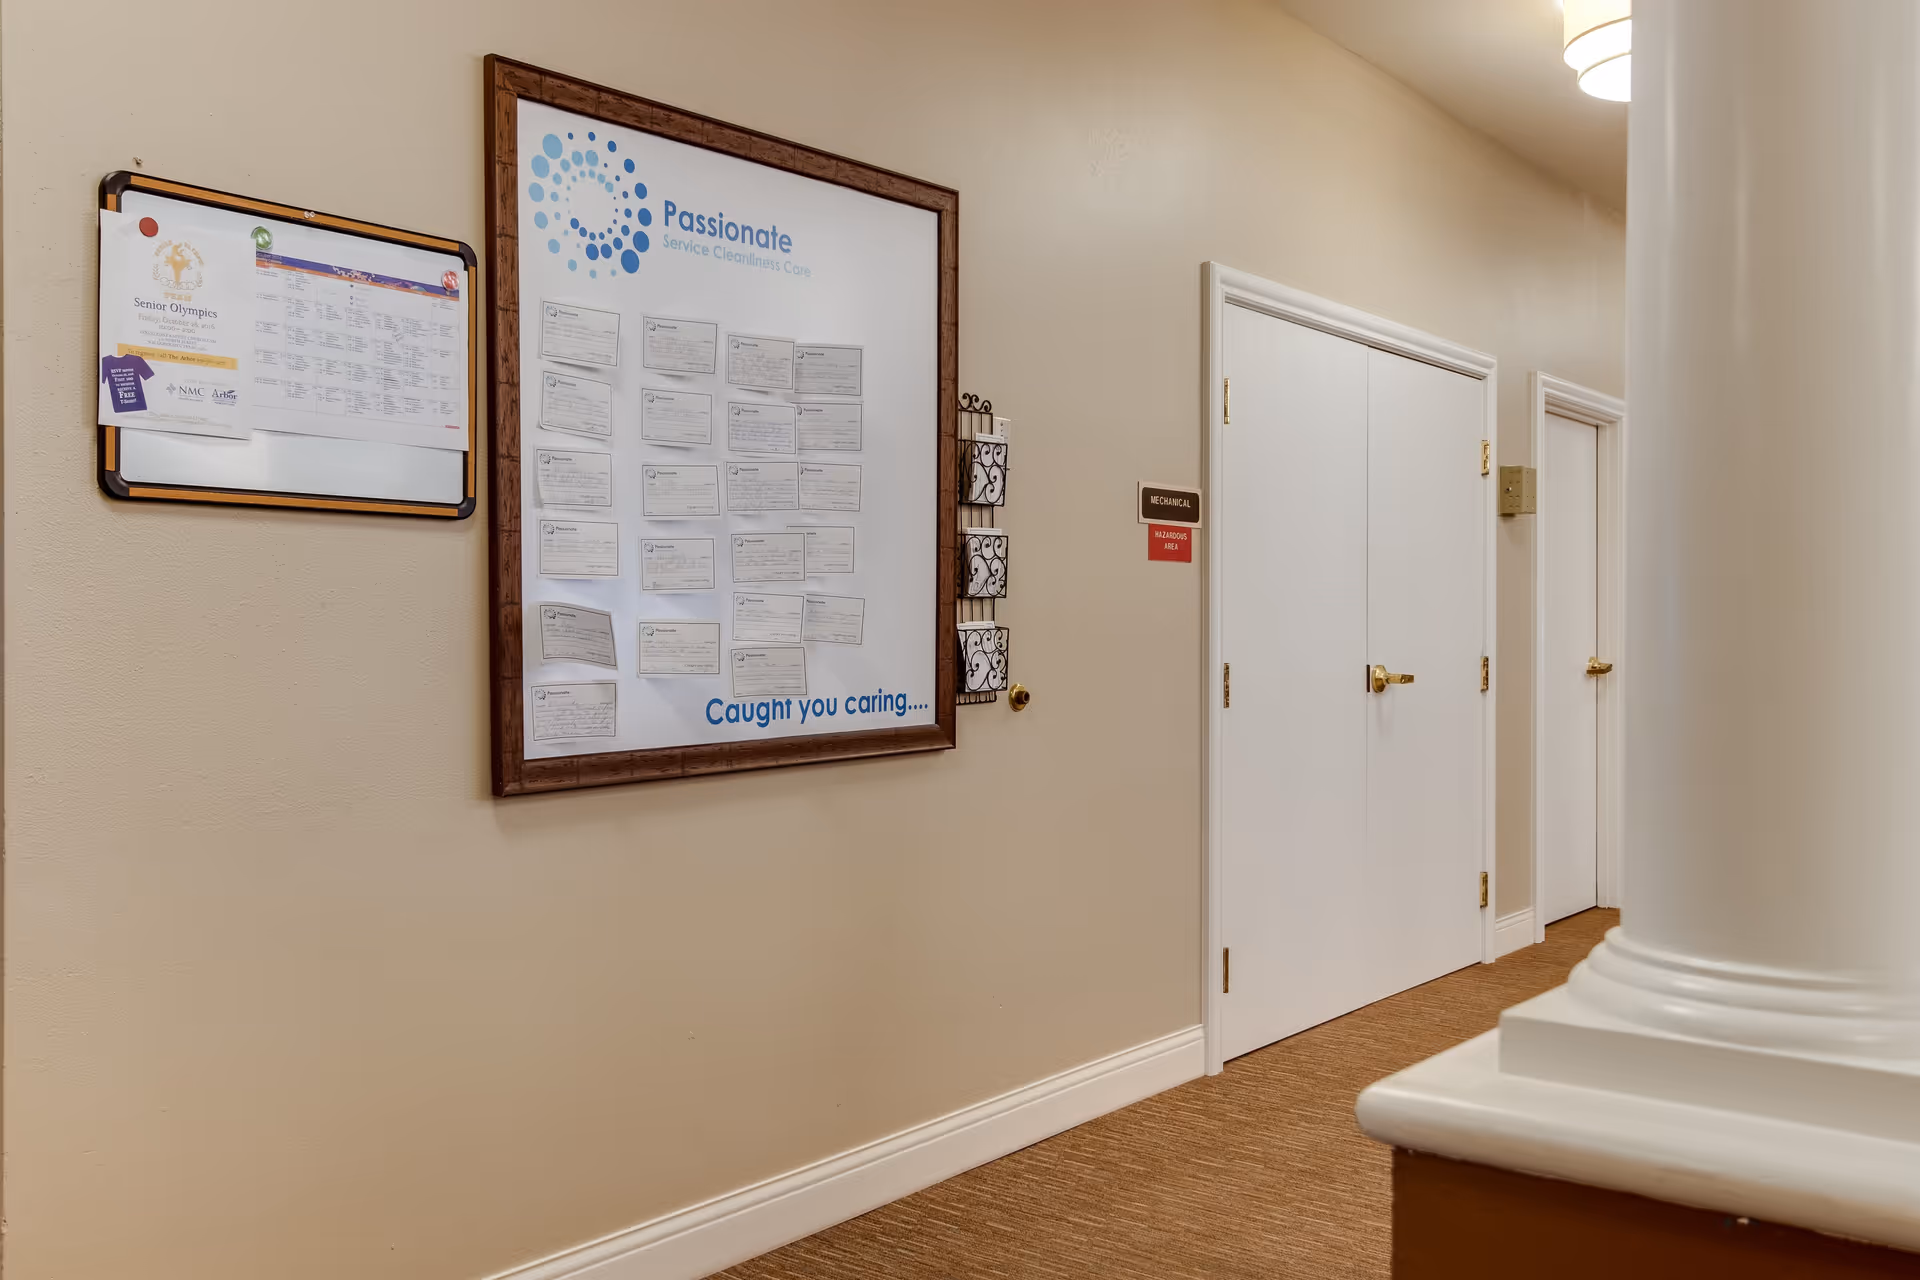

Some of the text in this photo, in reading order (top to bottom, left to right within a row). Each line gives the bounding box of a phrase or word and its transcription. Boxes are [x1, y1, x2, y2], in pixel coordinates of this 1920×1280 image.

[664, 199, 793, 254] Passionate
[663, 234, 811, 278] Service Cleanliness Care
[134, 297, 218, 319] Senior Olympics
[119, 391, 136, 399] FREE
[179, 385, 205, 397] NMC
[211, 388, 238, 400] Arbor
[1150, 496, 1191, 508] MECHANICAL
[1154, 530, 1188, 541] HAZARDOUS
[1164, 543, 1178, 551] AREA
[706, 688, 929, 728] Caught you caring....
